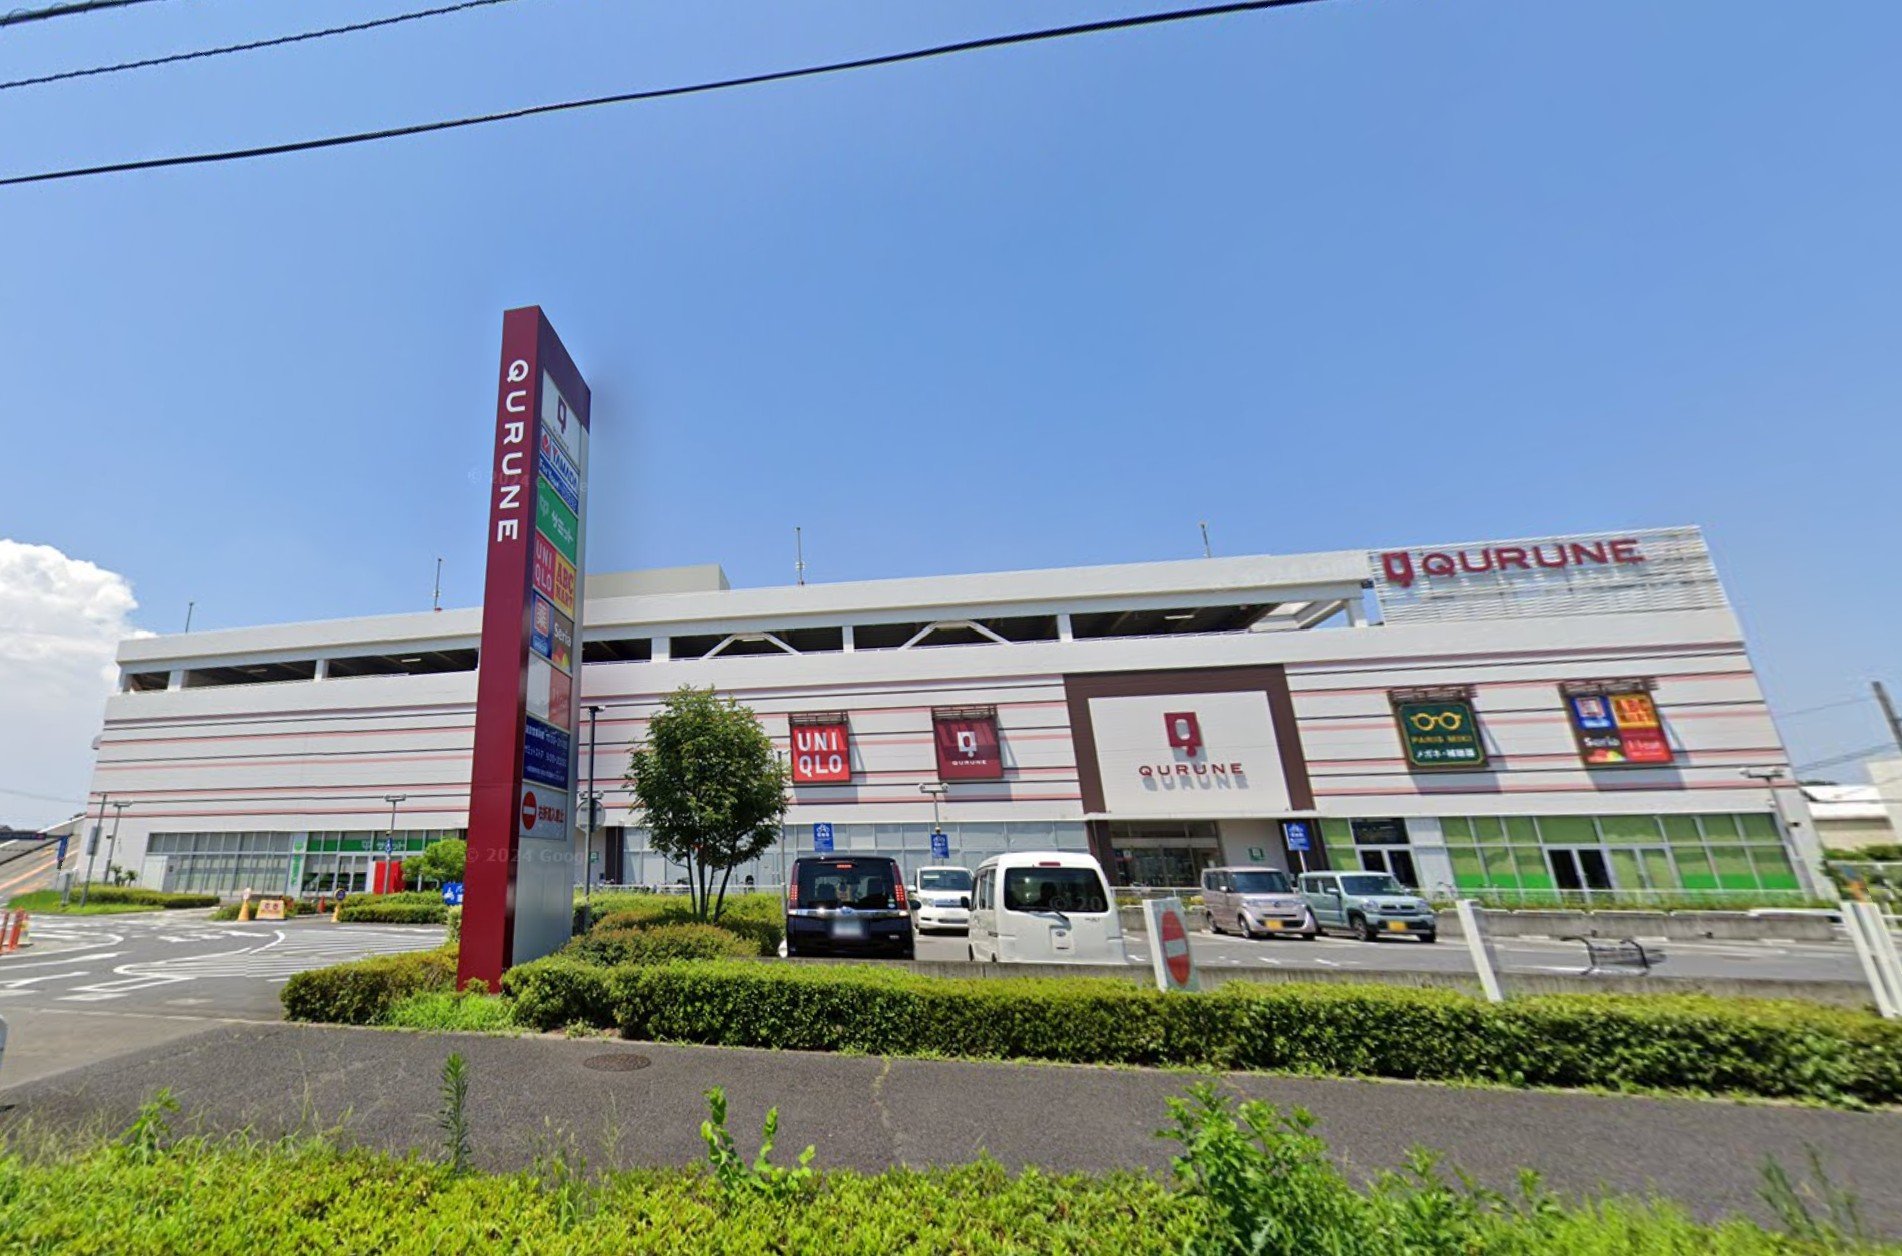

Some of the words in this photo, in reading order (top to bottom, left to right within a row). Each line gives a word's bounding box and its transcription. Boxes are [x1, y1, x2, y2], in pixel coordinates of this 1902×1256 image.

[497, 359, 529, 542] QURUNE
[535, 540, 553, 570] UNI
[1421, 538, 1647, 578] QURUNE
[535, 563, 552, 593] QLO
[556, 562, 574, 594] ABC
[554, 623, 572, 646] Seria
[798, 731, 838, 752] UNI
[798, 754, 843, 778] QLO
[1138, 763, 1244, 777] QURUNE
